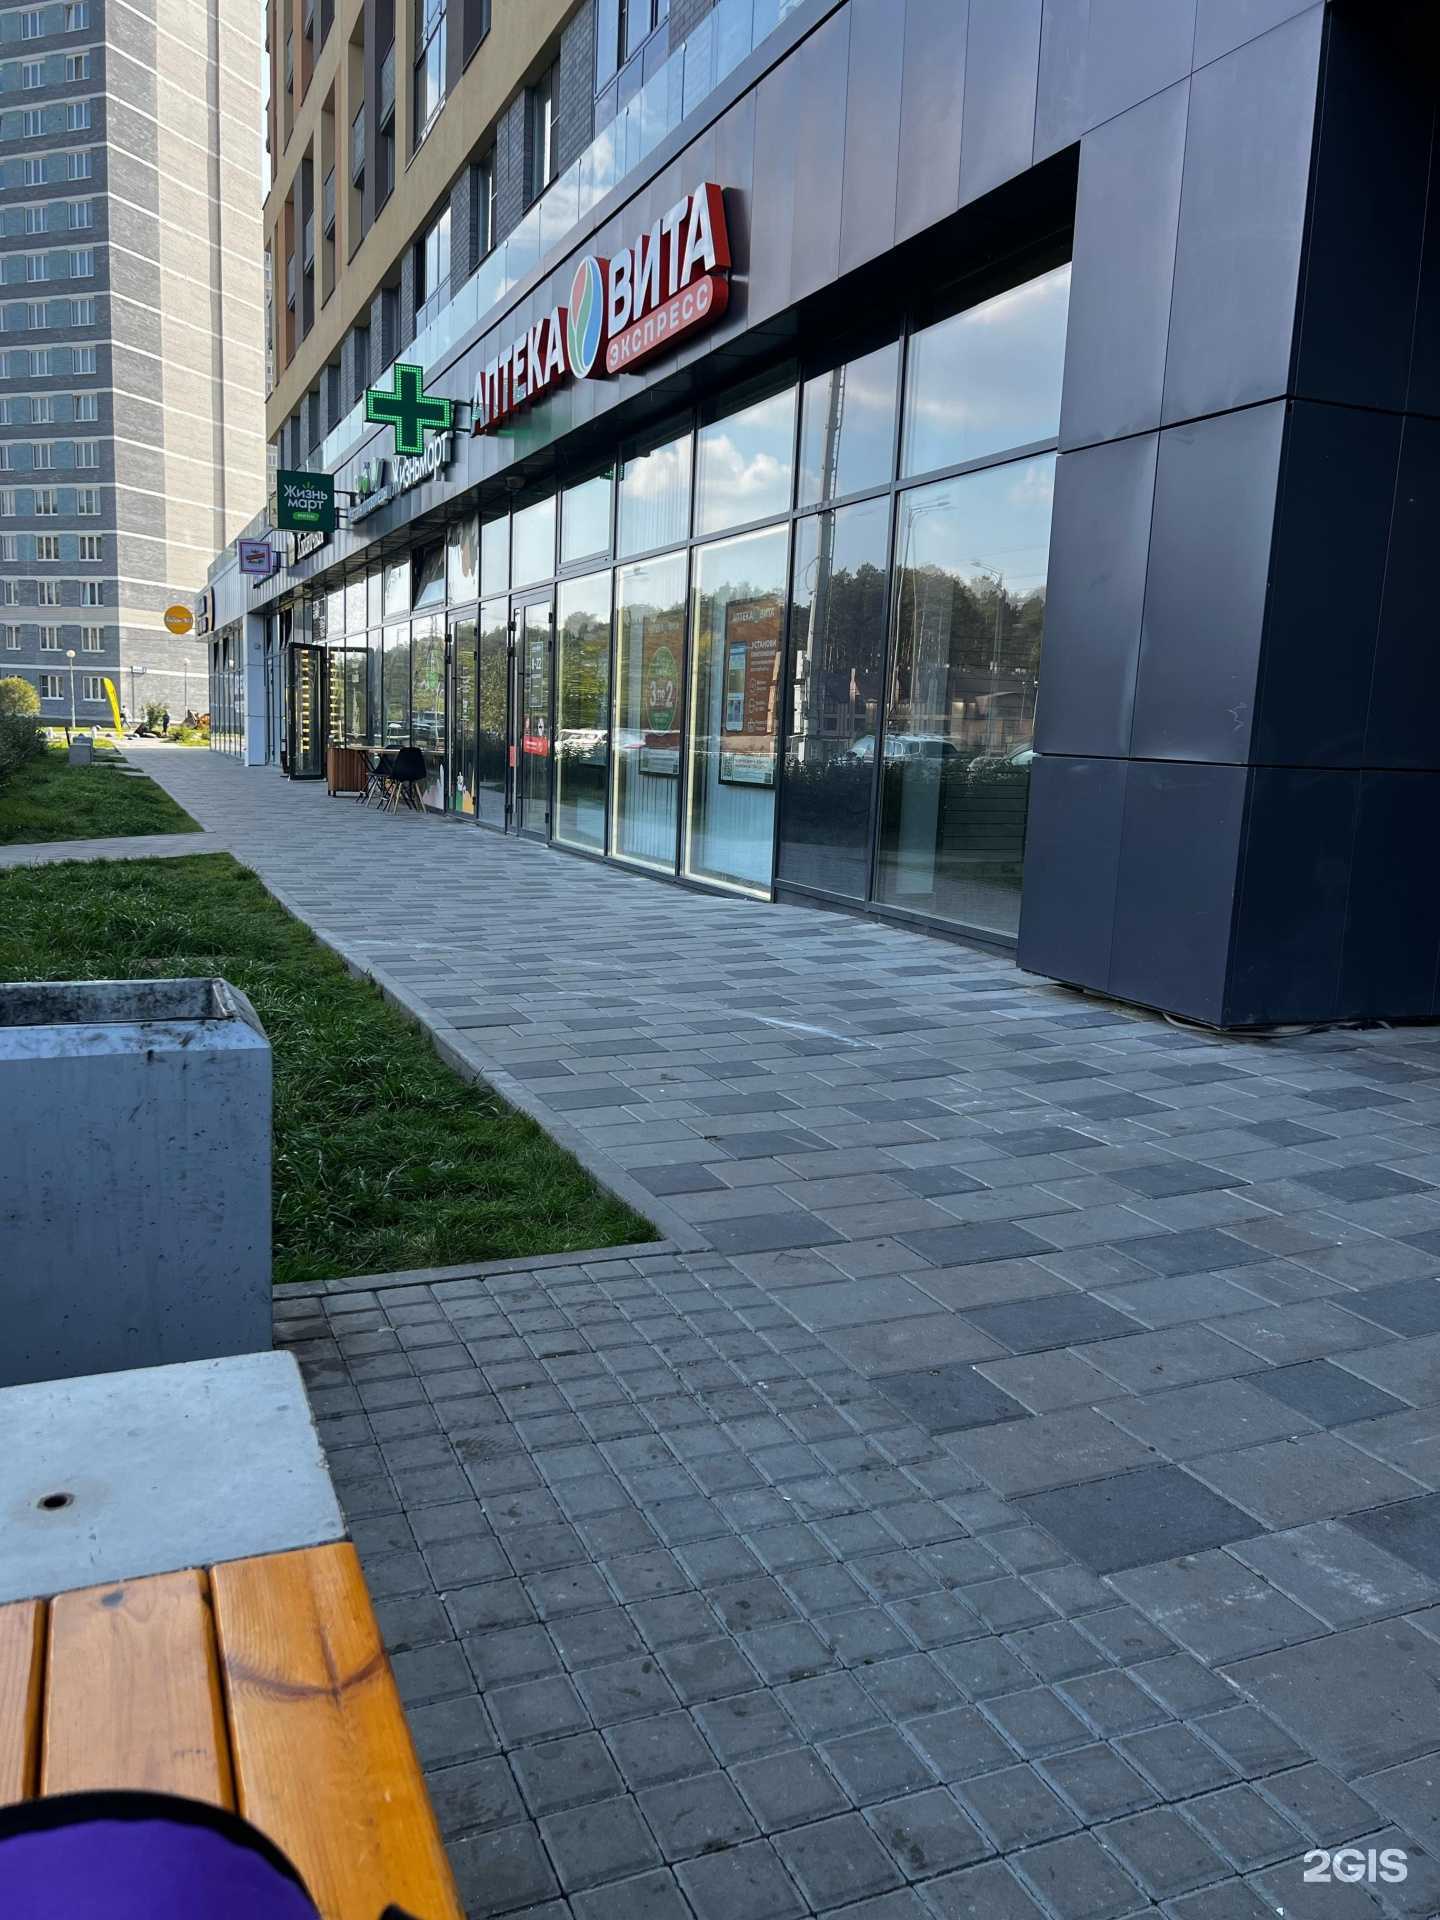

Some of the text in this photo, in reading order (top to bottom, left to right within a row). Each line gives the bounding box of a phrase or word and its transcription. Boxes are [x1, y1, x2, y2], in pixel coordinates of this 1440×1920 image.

[471, 182, 717, 429] АПТЕКА ВИТА
[609, 284, 710, 366] ЭКСПРЕСС
[283, 484, 328, 500] Жизнь
[287, 497, 324, 512] март
